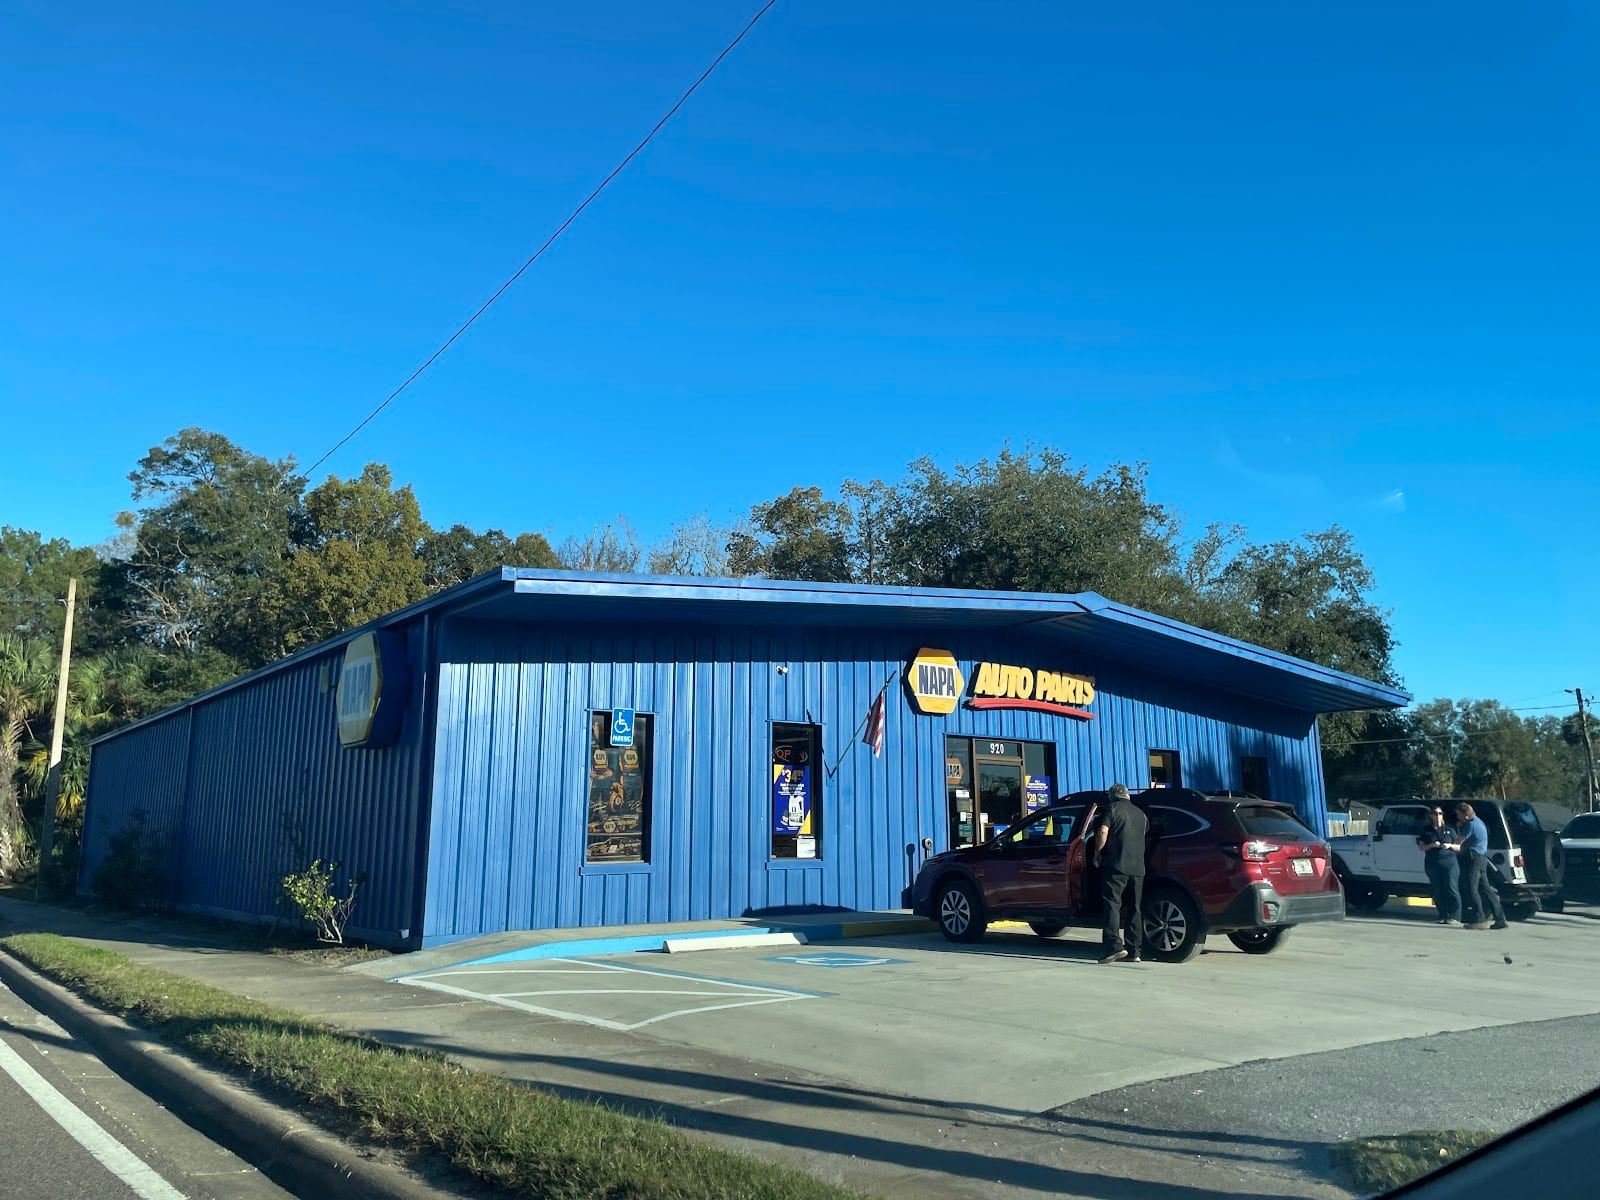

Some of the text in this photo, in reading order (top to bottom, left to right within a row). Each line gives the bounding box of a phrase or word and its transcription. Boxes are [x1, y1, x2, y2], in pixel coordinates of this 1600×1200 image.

[341, 662, 372, 716] NAPA
[918, 662, 1096, 706] NAPA AUTO PARTS
[990, 743, 1005, 754] 920
